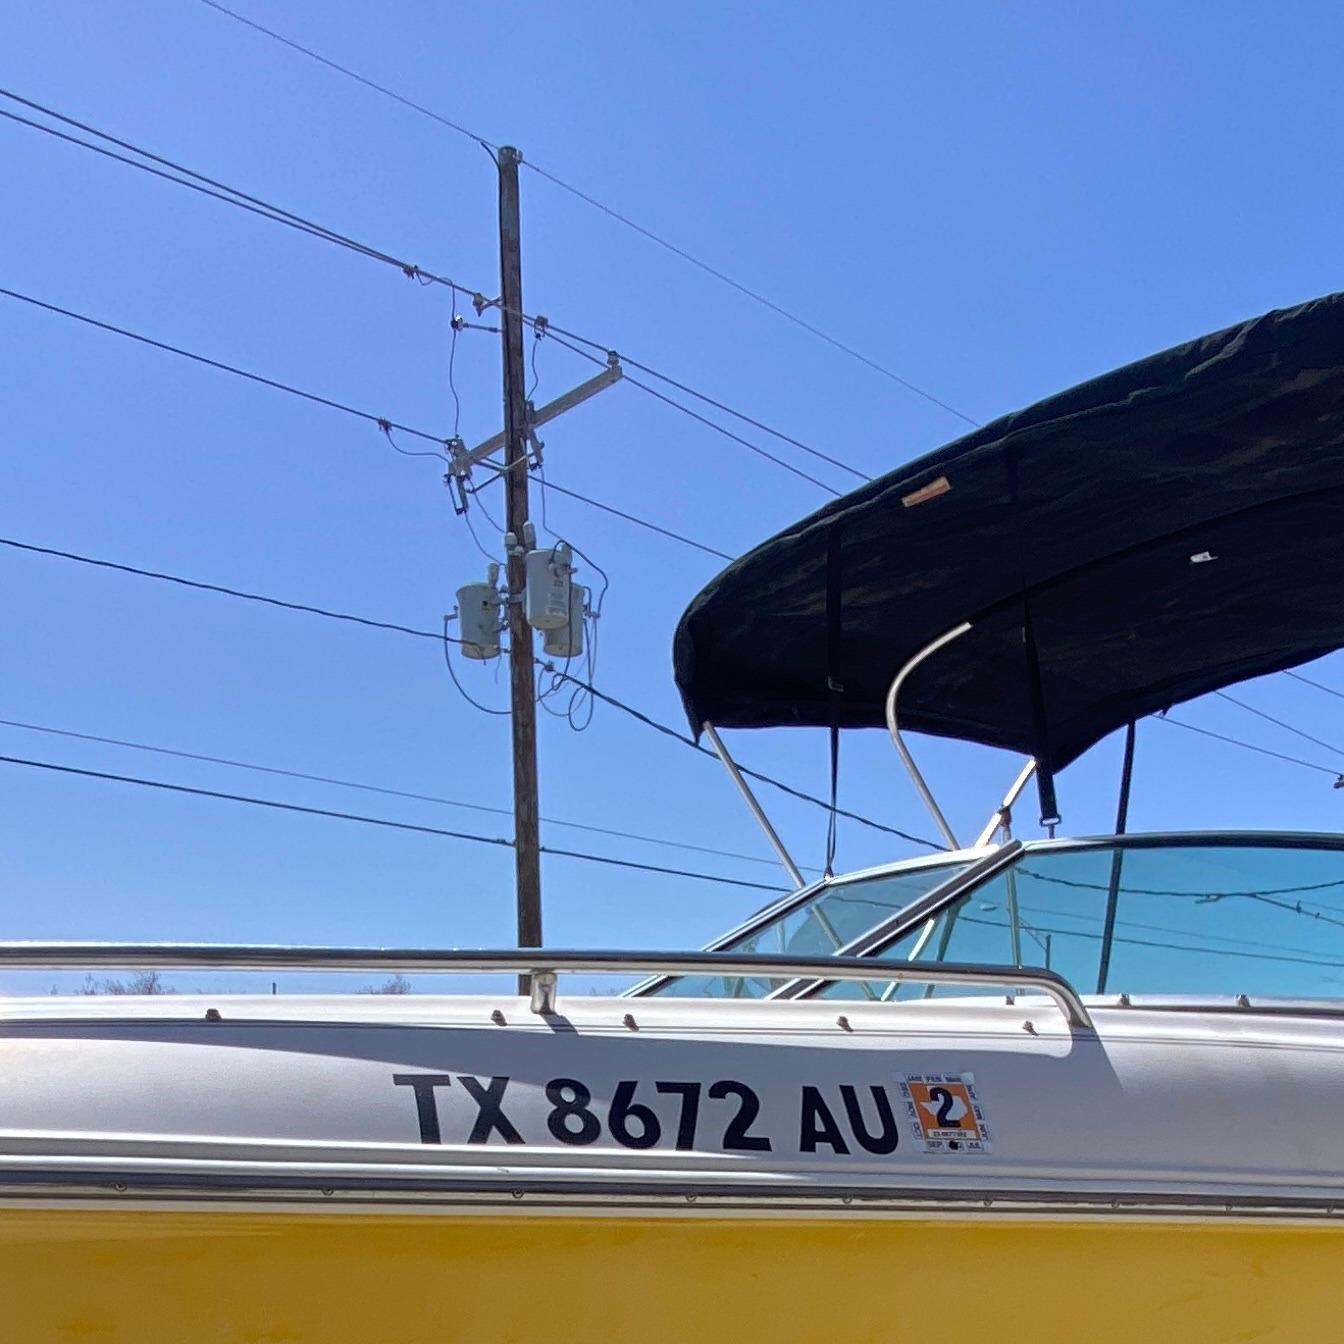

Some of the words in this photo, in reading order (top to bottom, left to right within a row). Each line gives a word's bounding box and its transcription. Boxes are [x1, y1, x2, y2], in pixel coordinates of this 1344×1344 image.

[393, 1073, 526, 1145] TX
[545, 1078, 772, 1151] 8672
[799, 1085, 899, 1155] AU
[929, 1087, 961, 1128] 2
